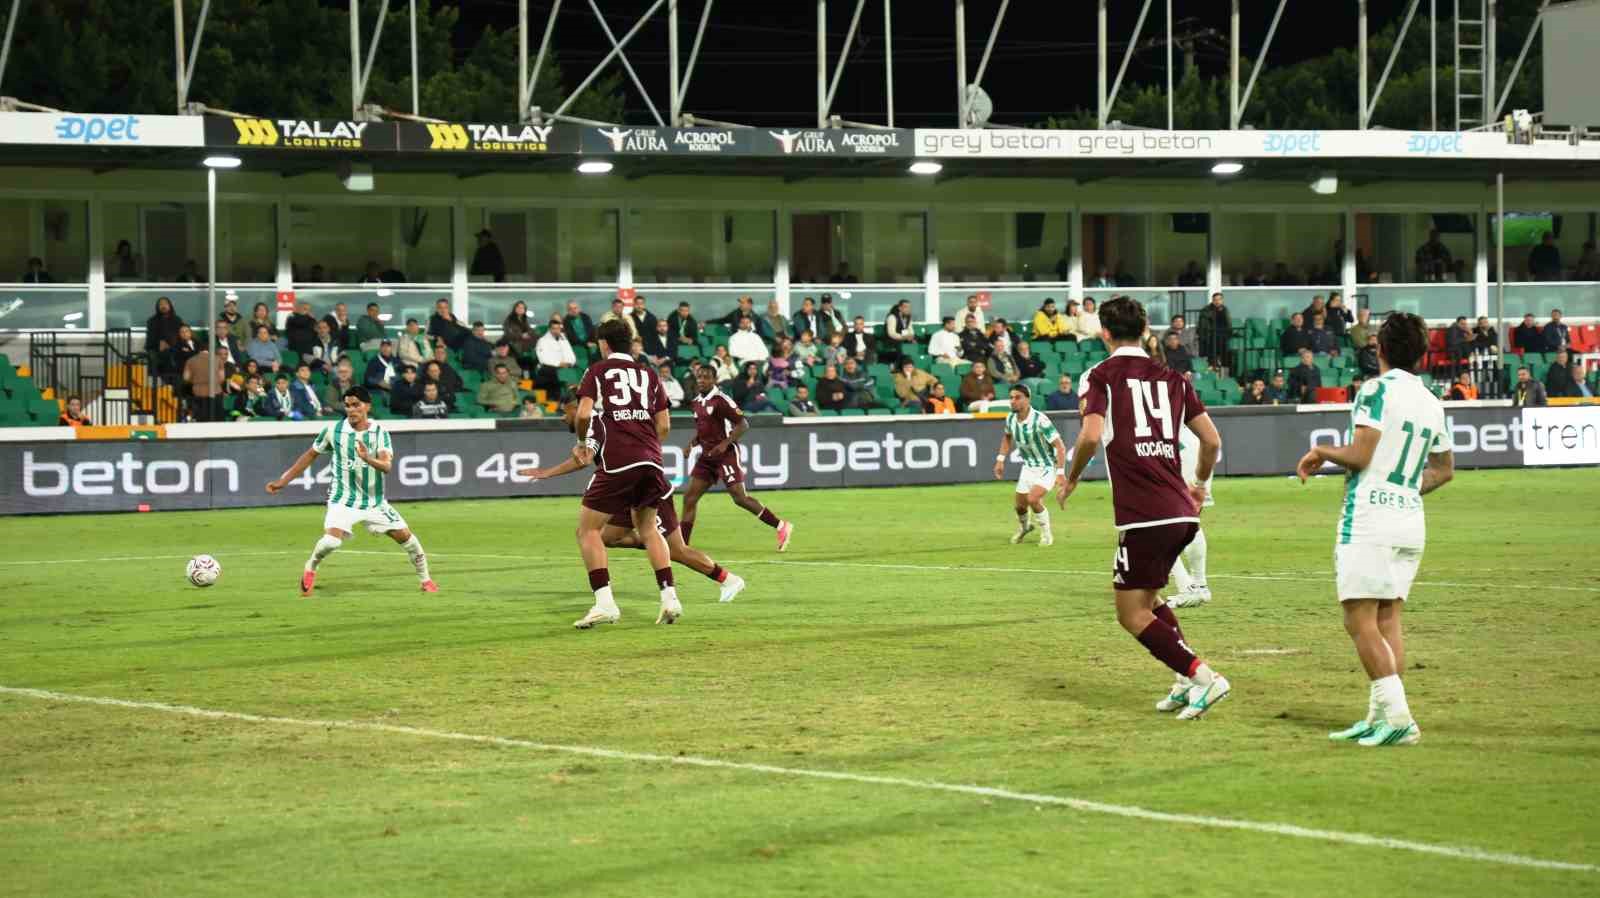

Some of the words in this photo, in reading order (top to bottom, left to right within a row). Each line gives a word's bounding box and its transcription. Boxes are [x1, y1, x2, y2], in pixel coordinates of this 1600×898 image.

[56, 116, 139, 142] opet
[278, 120, 368, 137] TALAY
[468, 124, 553, 141] TALAY
[674, 131, 736, 145] ACROPOL
[841, 132, 899, 146] ACROPOL
[284, 138, 361, 147] LOGISTICS
[474, 142, 548, 150] LOGISTICS
[626, 136, 668, 151] AURA
[796, 138, 835, 152] AURA
[923, 133, 982, 153] grey
[990, 131, 1061, 149] beton
[1078, 134, 1134, 154] grey
[1142, 132, 1212, 150] beton
[1263, 129, 1321, 155] opet
[1406, 130, 1463, 155] opet
[604, 367, 649, 410] 34
[1127, 378, 1174, 440] 14
[1532, 417, 1598, 450] tren
[809, 432, 977, 472] beton
[1384, 420, 1431, 489] 11
[23, 451, 239, 496] beton
[398, 454, 463, 486] 60
[476, 452, 540, 483] 48
